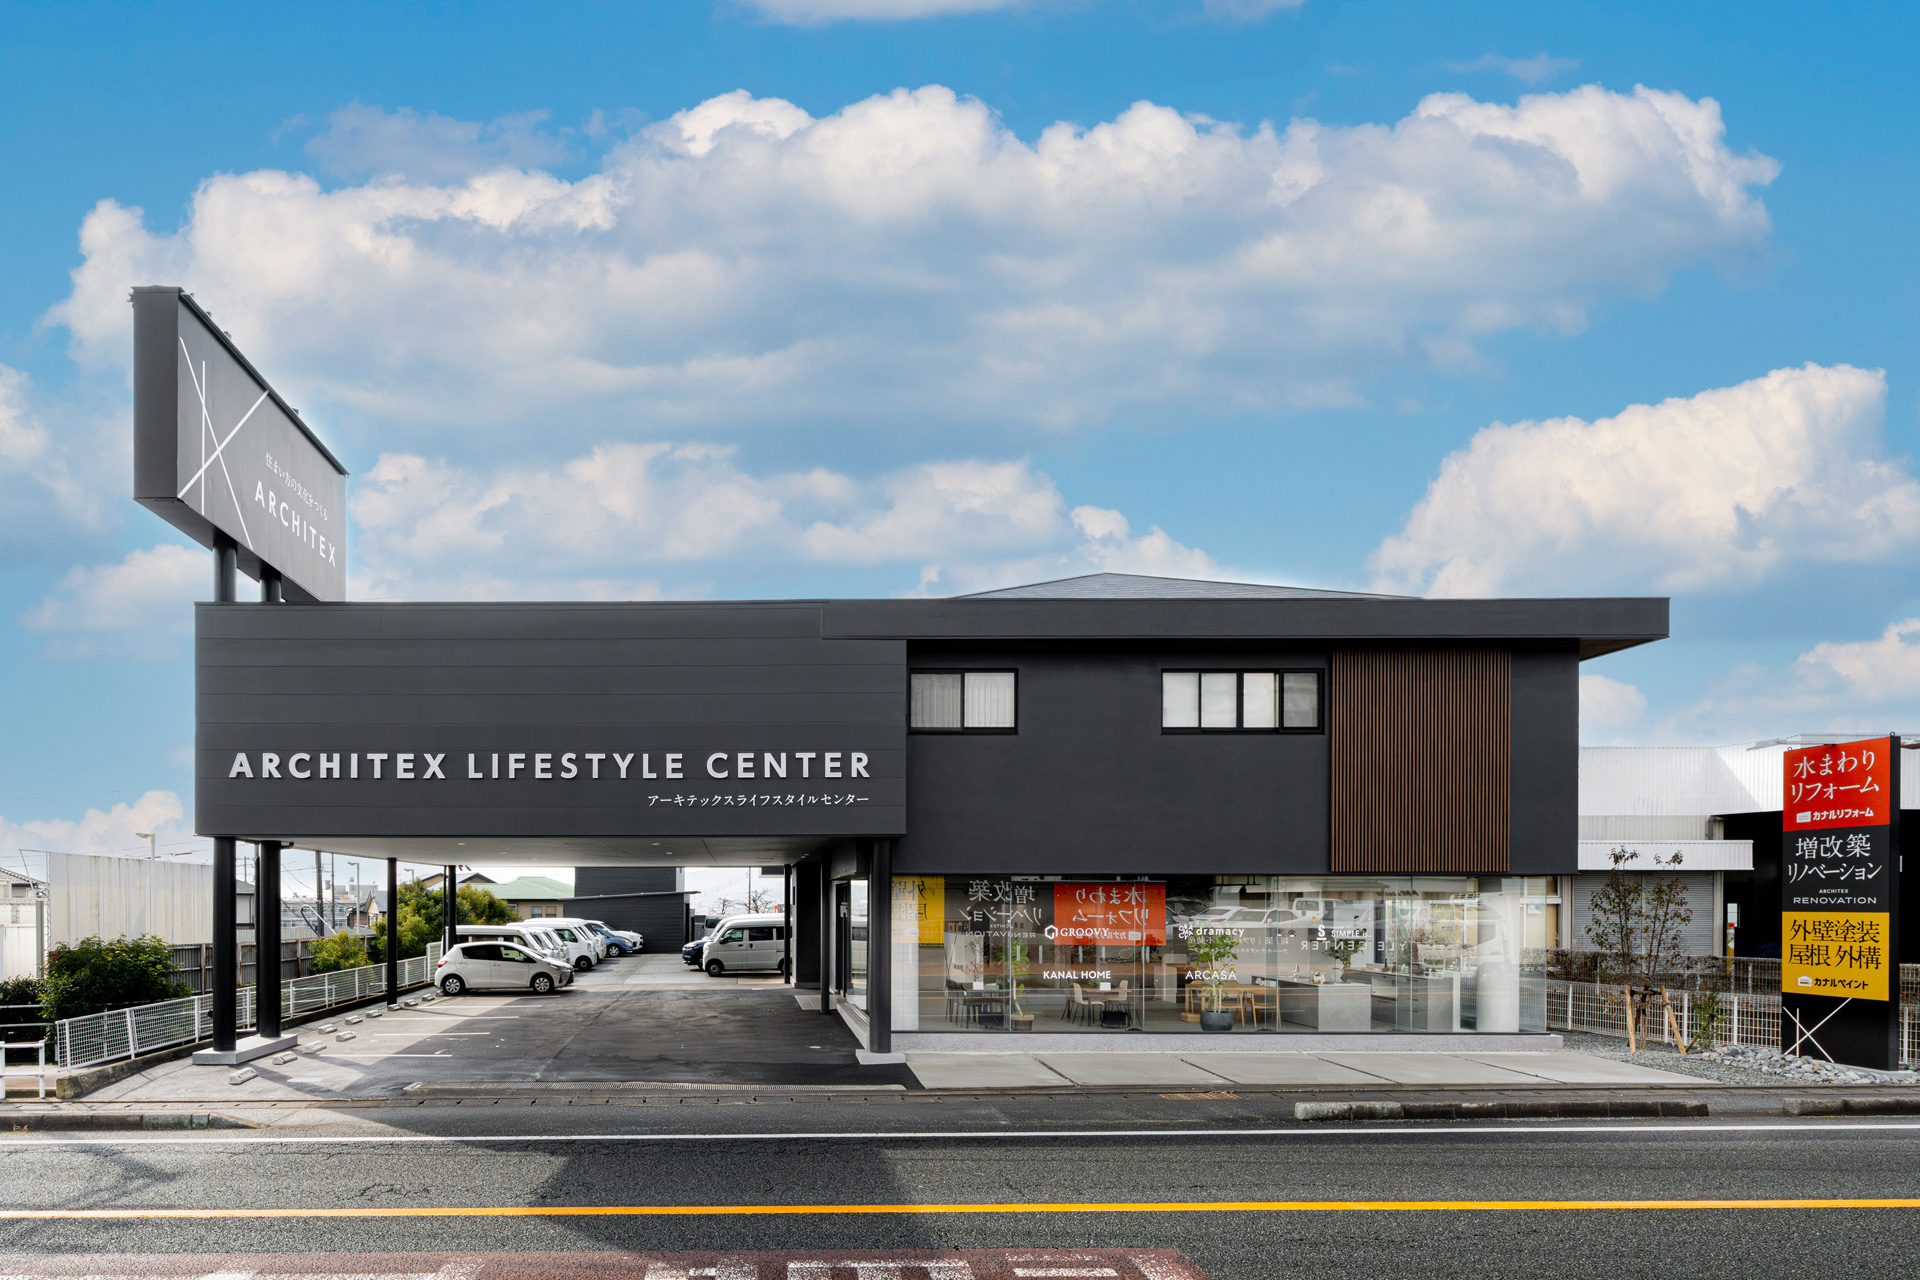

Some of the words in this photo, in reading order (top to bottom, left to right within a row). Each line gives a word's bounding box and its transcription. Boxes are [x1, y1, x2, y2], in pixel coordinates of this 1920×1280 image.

[265, 451, 328, 521] 住まい方の文化をつくる
[255, 480, 336, 567] ARCHITEX
[228, 752, 446, 779] ARCHITEX
[468, 752, 684, 779] LIFESTYLE
[706, 752, 871, 779] CENTER
[1793, 749, 1875, 779] 水まわり
[1791, 776, 1880, 804] リフォーム
[648, 794, 869, 807] アーキテックスライフスタイルセンター
[1813, 807, 1874, 821] カナルリフォーム
[1795, 833, 1872, 860] 増改築
[1788, 862, 1883, 884] リノベーション
[1793, 896, 1877, 904] RENOVATION
[1060, 928, 1110, 937] GROOVY
[1196, 926, 1245, 937] dramacy
[1331, 929, 1360, 938] SIMPLE
[1789, 919, 1880, 943] 外壁塗装
[1788, 944, 1831, 967] 屋根
[1835, 945, 1882, 970] 外構
[1043, 970, 1079, 980] KANAL
[1081, 970, 1111, 980] HOME
[1185, 970, 1237, 980] ARCASA
[1814, 977, 1869, 990] カナルペイント
